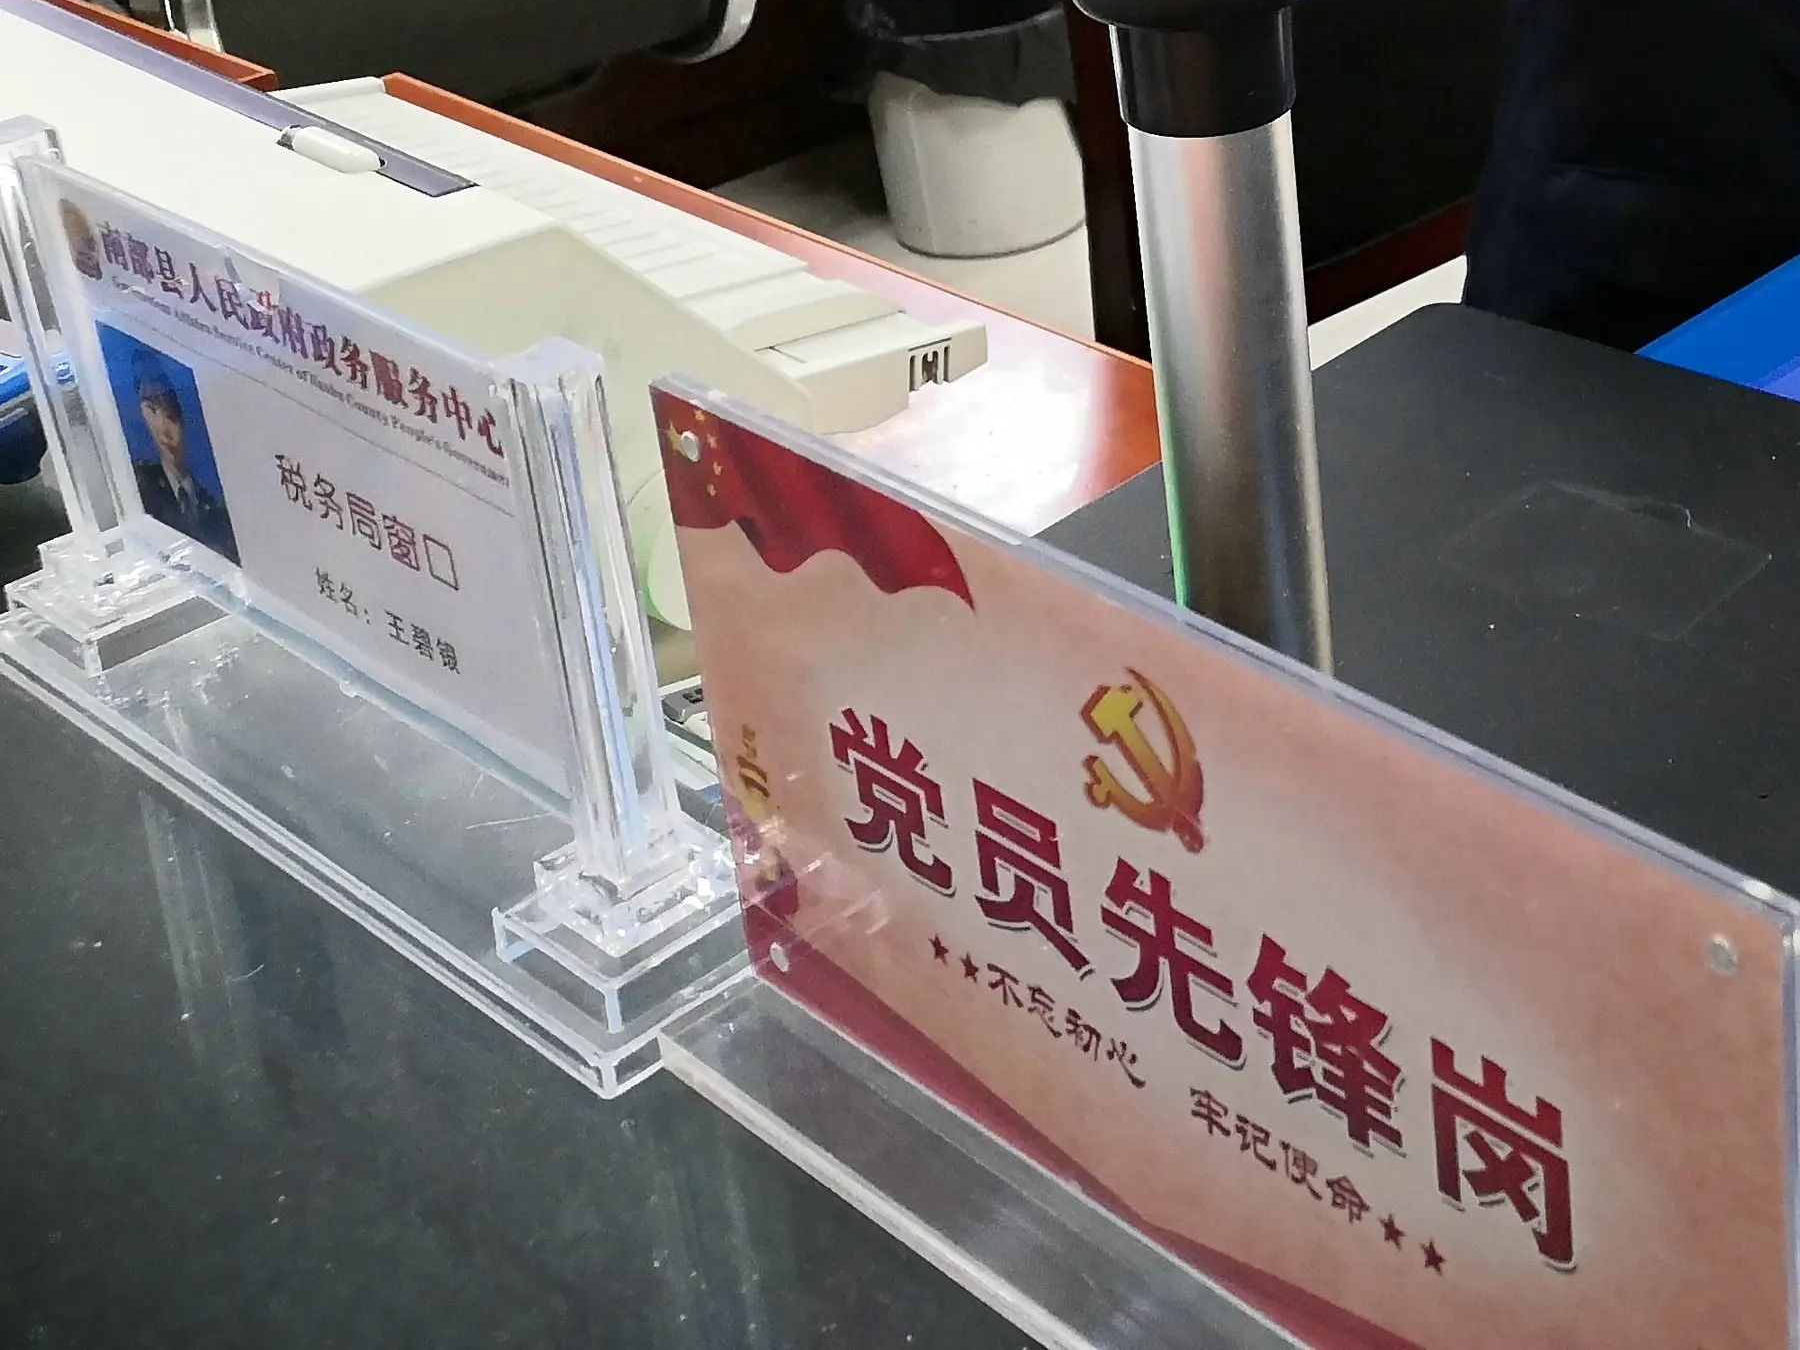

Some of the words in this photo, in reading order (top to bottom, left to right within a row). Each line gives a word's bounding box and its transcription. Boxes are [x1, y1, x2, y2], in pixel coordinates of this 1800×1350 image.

[275, 454, 460, 592] 税务局窗口
[827, 706, 1577, 1274] 党员先锋岗
[986, 961, 1147, 1089] 不忘初心
[1188, 1085, 1372, 1225] 牢记使命
